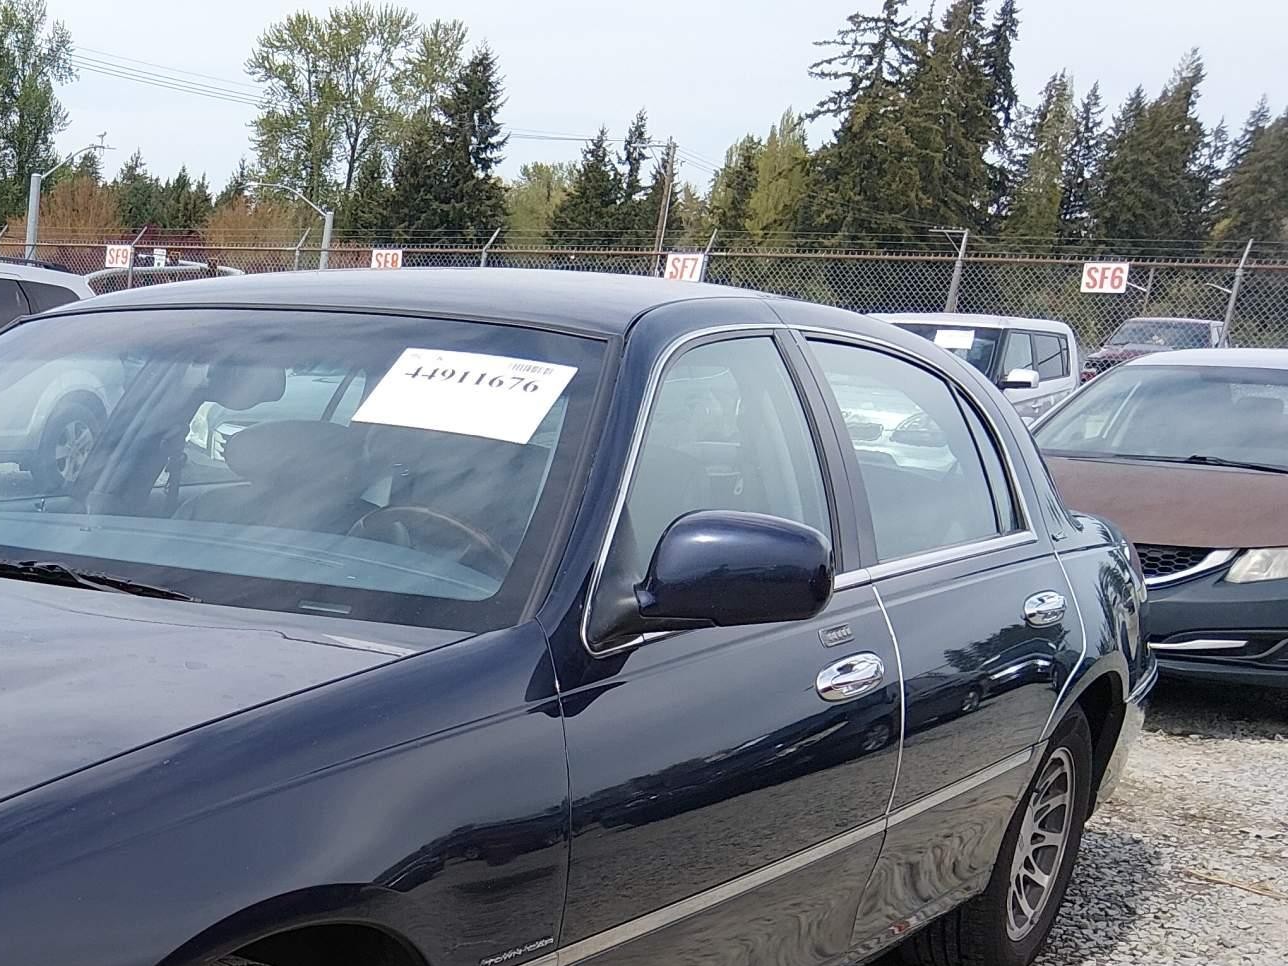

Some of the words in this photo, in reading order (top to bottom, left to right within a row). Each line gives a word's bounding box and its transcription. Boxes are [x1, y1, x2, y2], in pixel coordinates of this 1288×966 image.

[108, 248, 129, 266] SF9
[375, 252, 399, 268] SF8
[669, 257, 699, 280] SF7
[1085, 266, 1125, 289] SF6
[405, 365, 539, 393] 44911676
